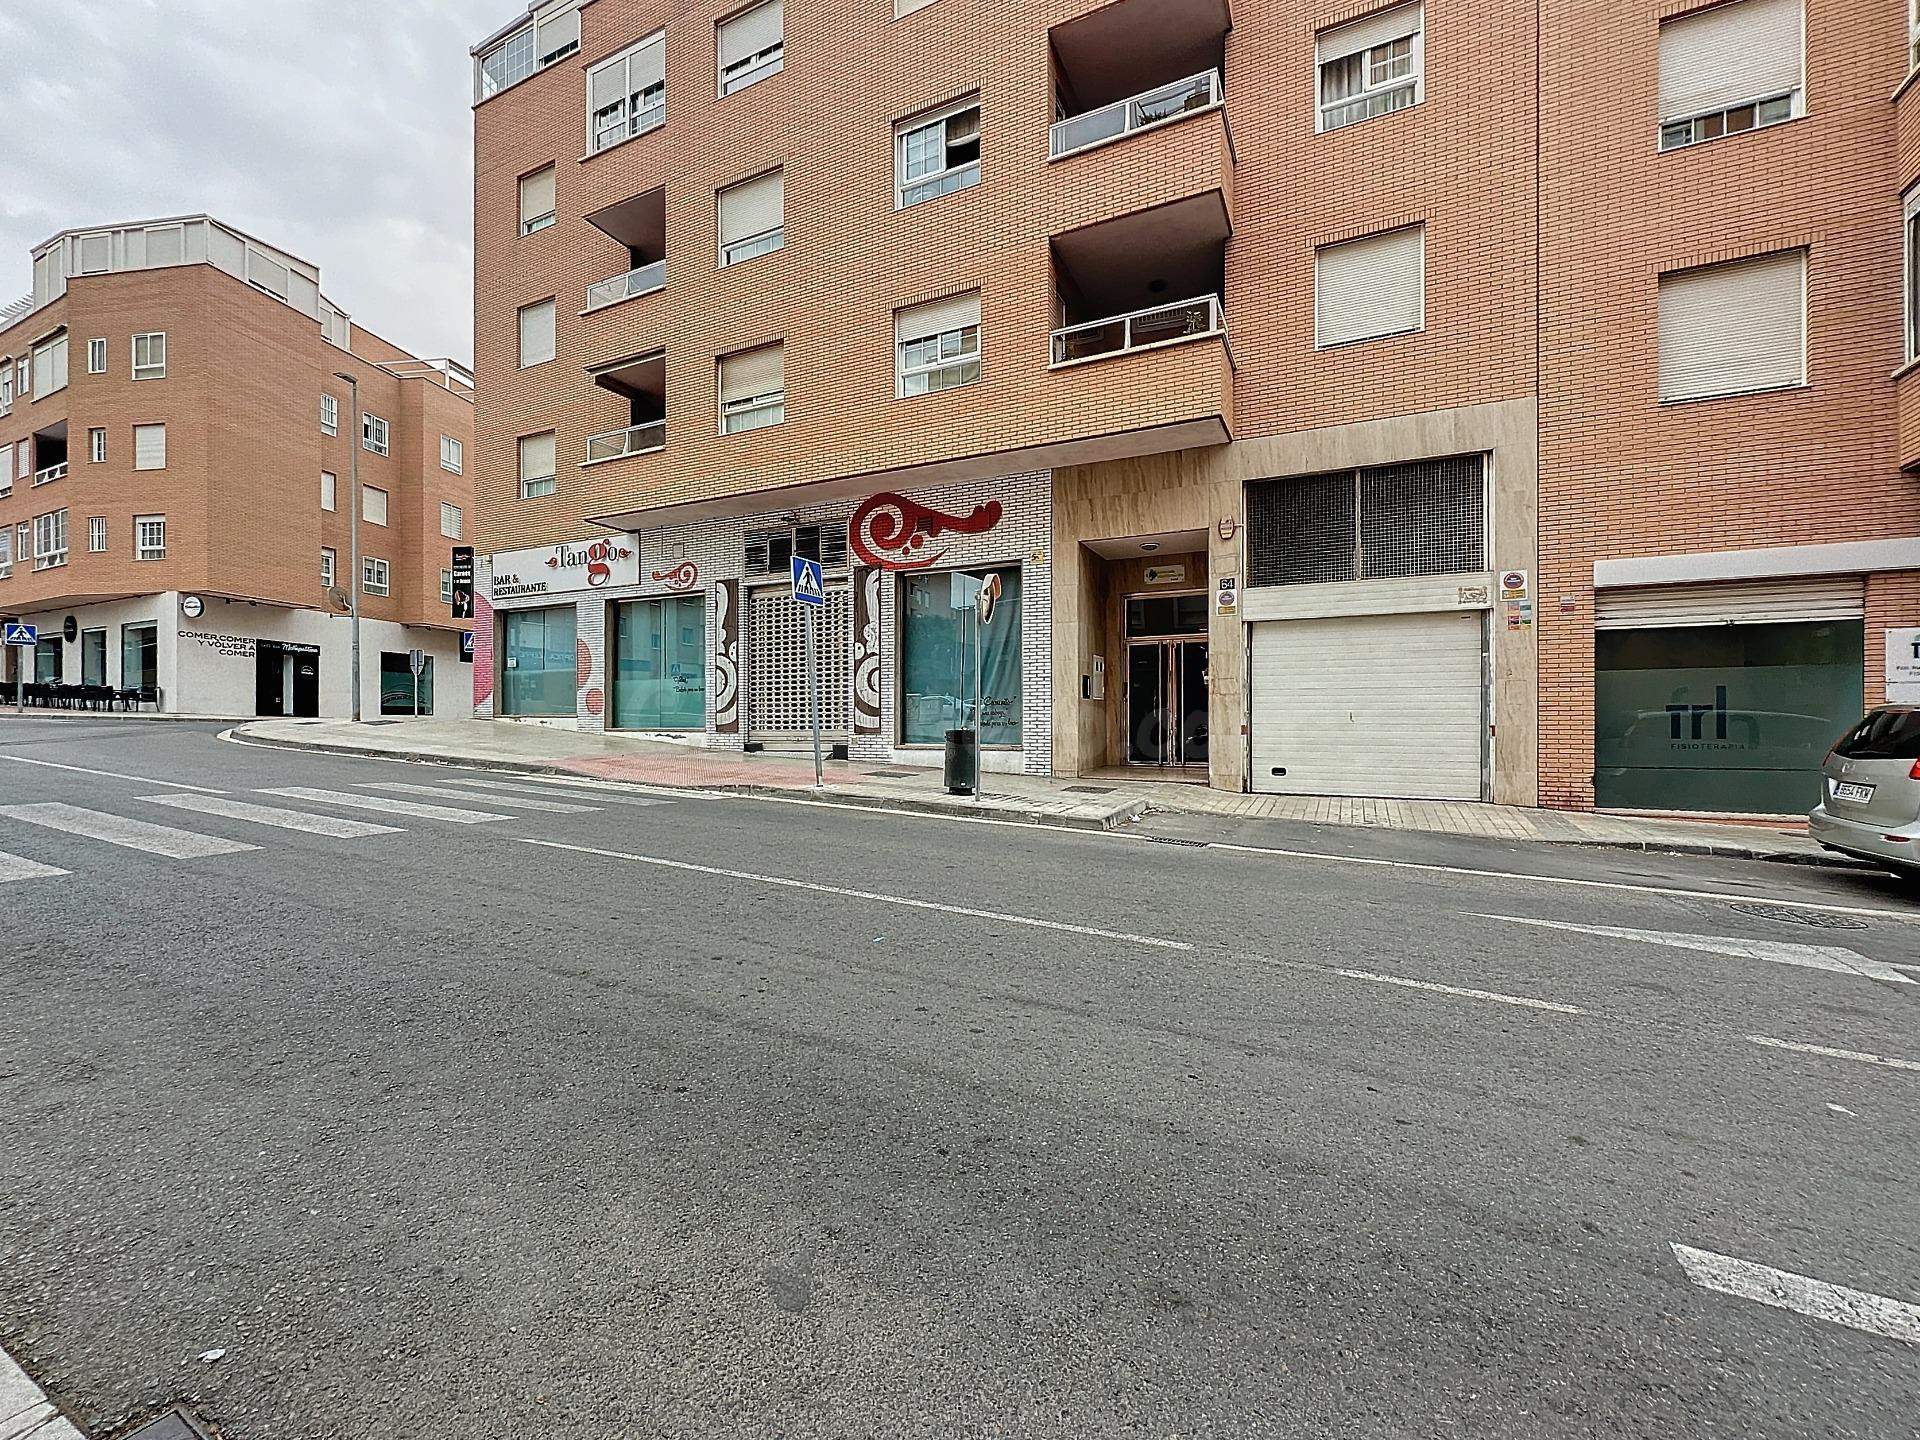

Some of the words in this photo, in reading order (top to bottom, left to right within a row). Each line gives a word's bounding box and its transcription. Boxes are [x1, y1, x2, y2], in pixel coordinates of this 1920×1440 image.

[555, 539, 618, 586] Tango
[493, 574, 511, 586] BAR
[512, 574, 520, 583] &
[1221, 579, 1234, 589] 64
[493, 582, 546, 596] RESTAURANTE
[198, 639, 205, 647] Y
[207, 640, 247, 651] VOLVER
[219, 635, 255, 645] COMER
[218, 648, 256, 658] COMER
